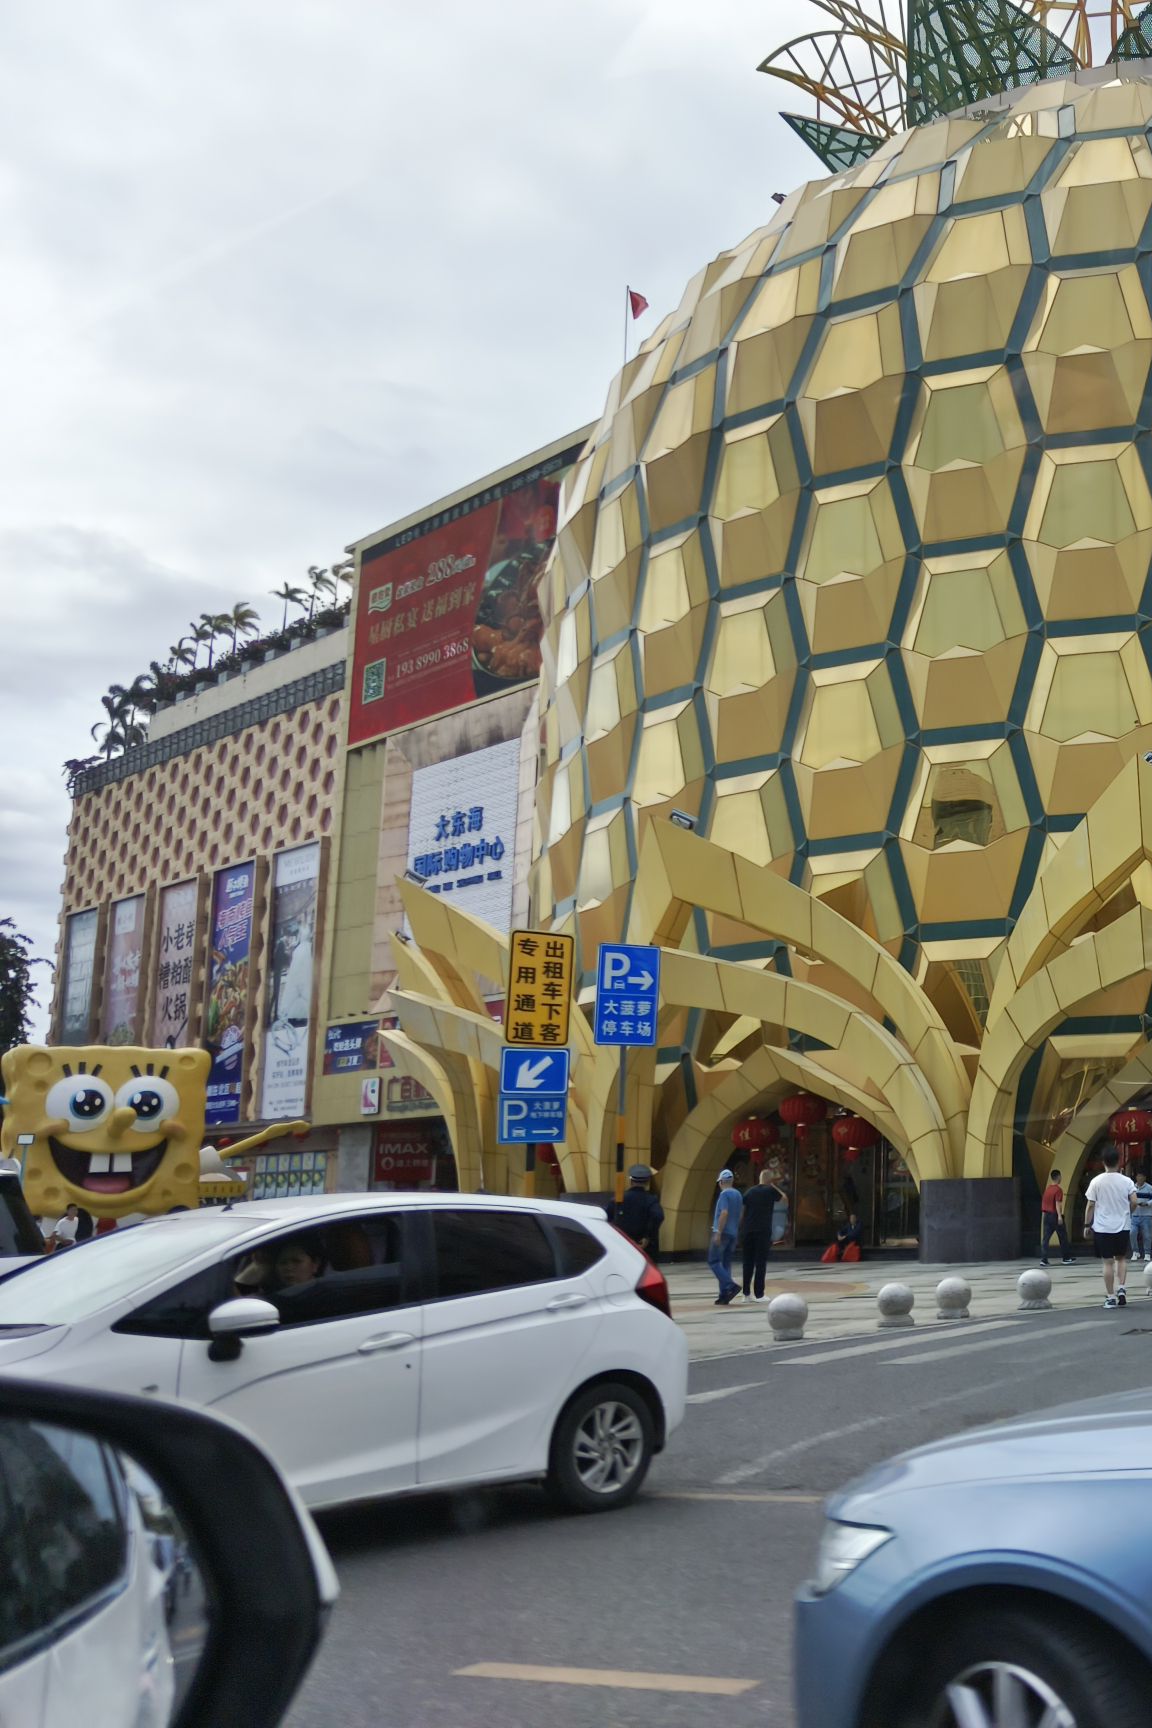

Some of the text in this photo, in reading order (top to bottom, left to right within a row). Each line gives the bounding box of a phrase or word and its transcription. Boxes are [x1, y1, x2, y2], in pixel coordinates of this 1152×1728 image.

[434, 807, 484, 841] 大东海
[414, 835, 506, 877] 国际购物中心
[512, 938, 540, 1041] 专用通道
[603, 951, 631, 990] P
[539, 940, 565, 1042] 出租车下客
[604, 1000, 652, 1017] 大菠萝
[602, 1020, 651, 1037] 停车场
[503, 1100, 528, 1139] P
[379, 1143, 428, 1154] IMAX
